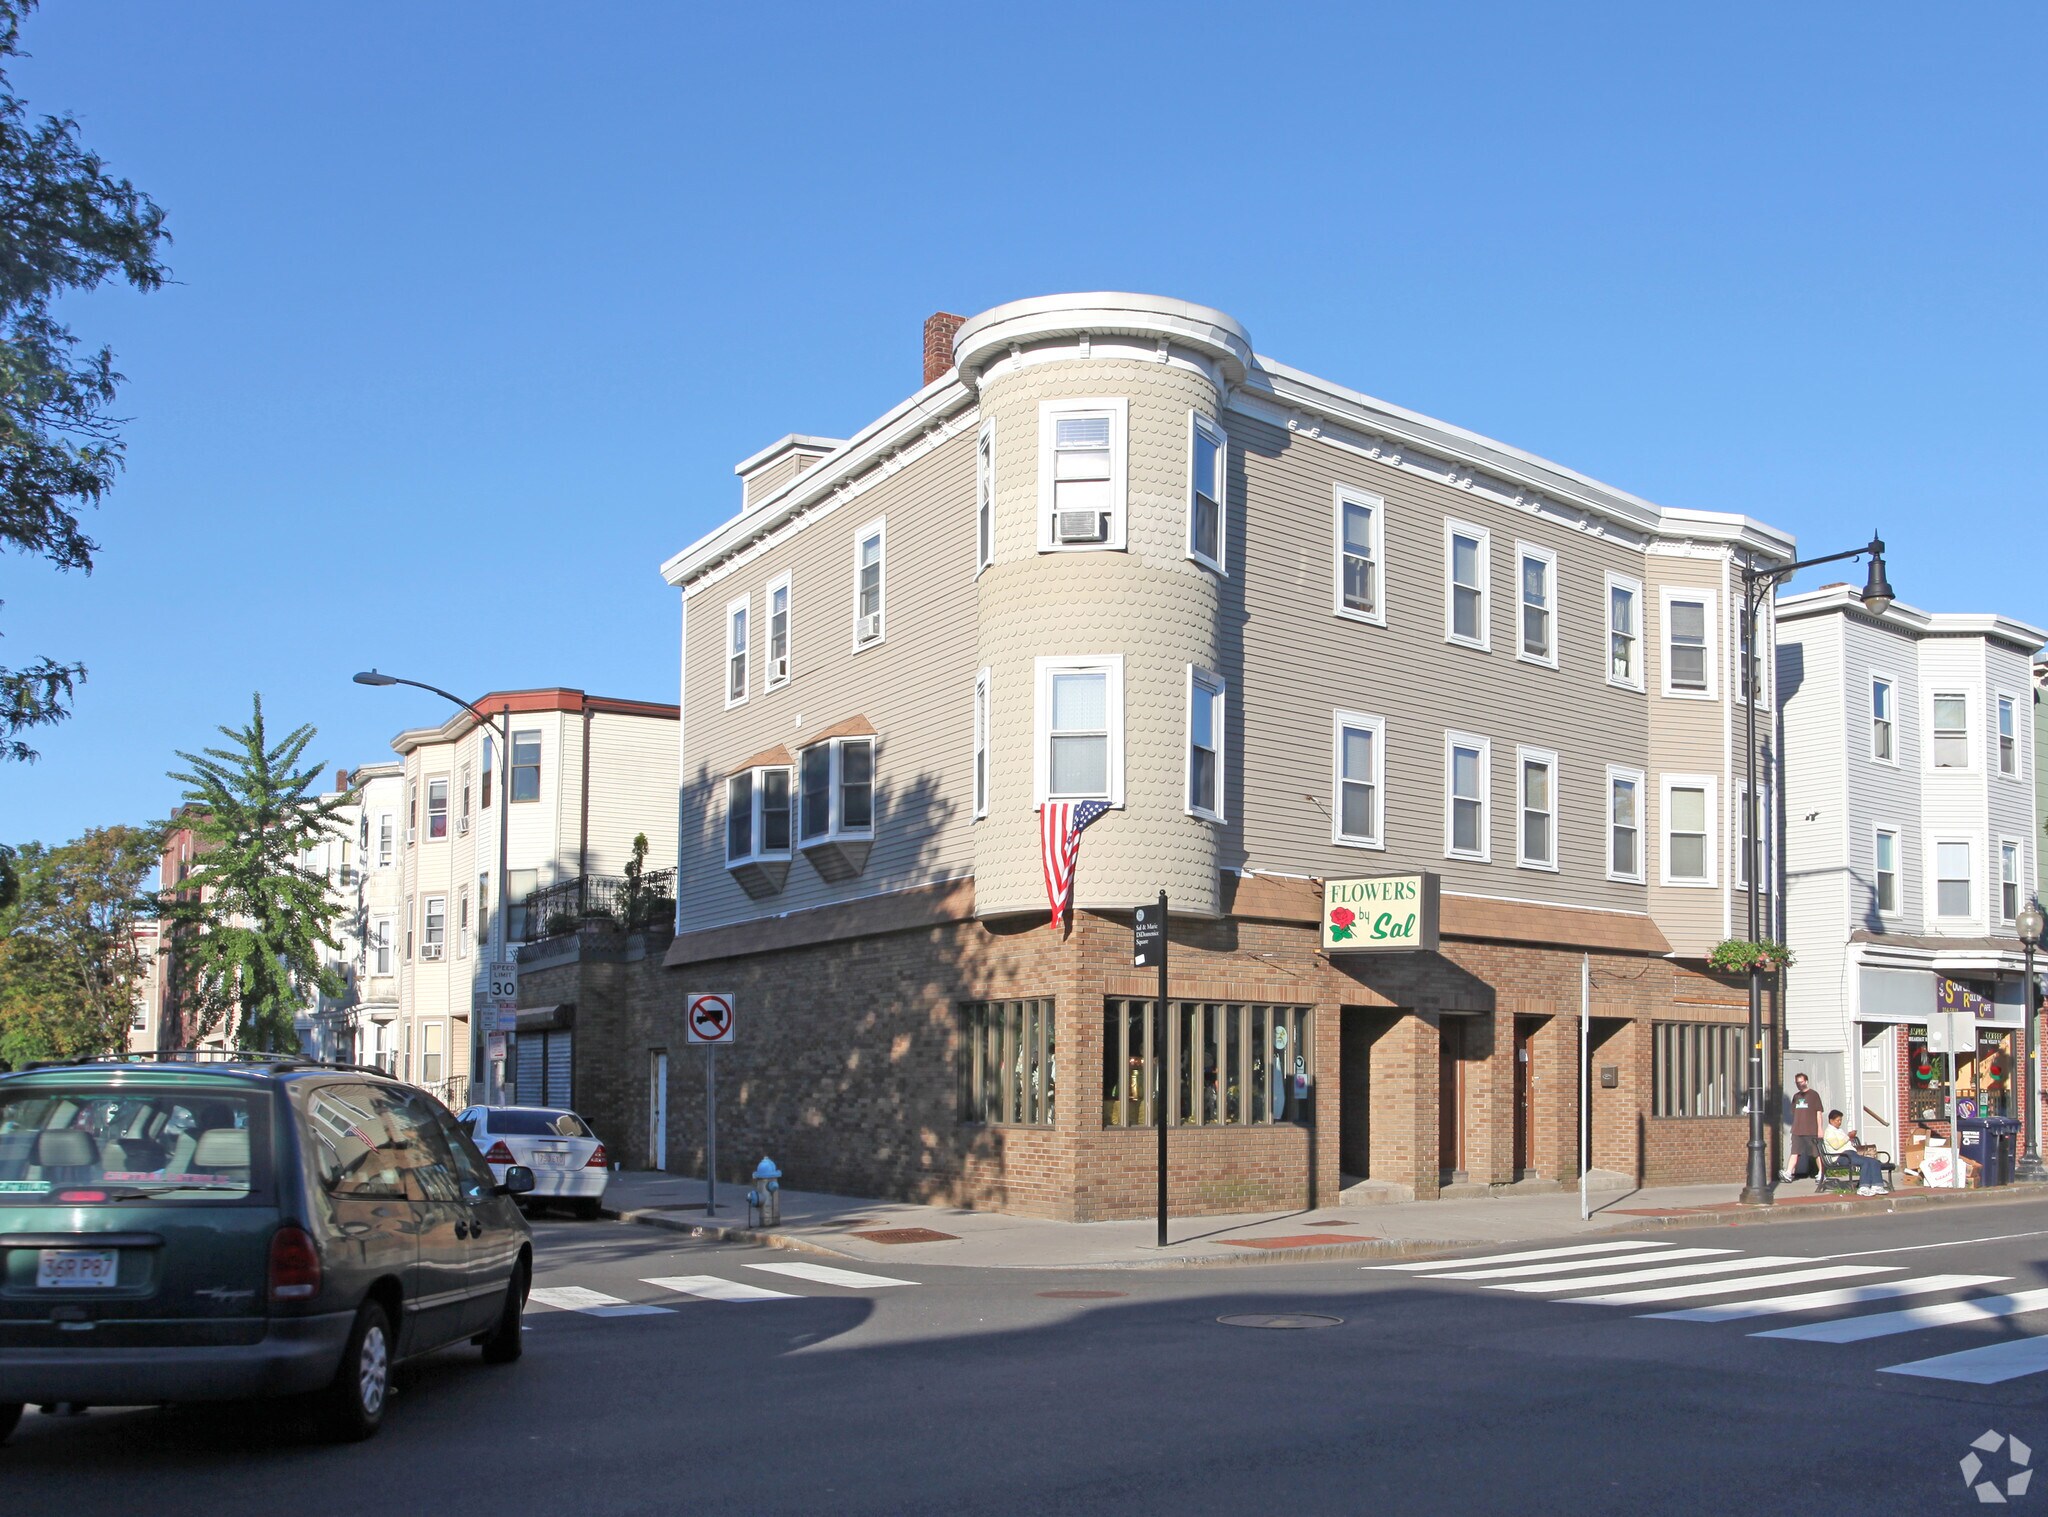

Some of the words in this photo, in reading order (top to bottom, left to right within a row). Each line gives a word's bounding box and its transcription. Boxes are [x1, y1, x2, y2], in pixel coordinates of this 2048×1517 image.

[1330, 881, 1416, 903] FLOWERS
[1358, 907, 1370, 925] by
[1370, 912, 1416, 940] Sal
[492, 982, 515, 995] 30
